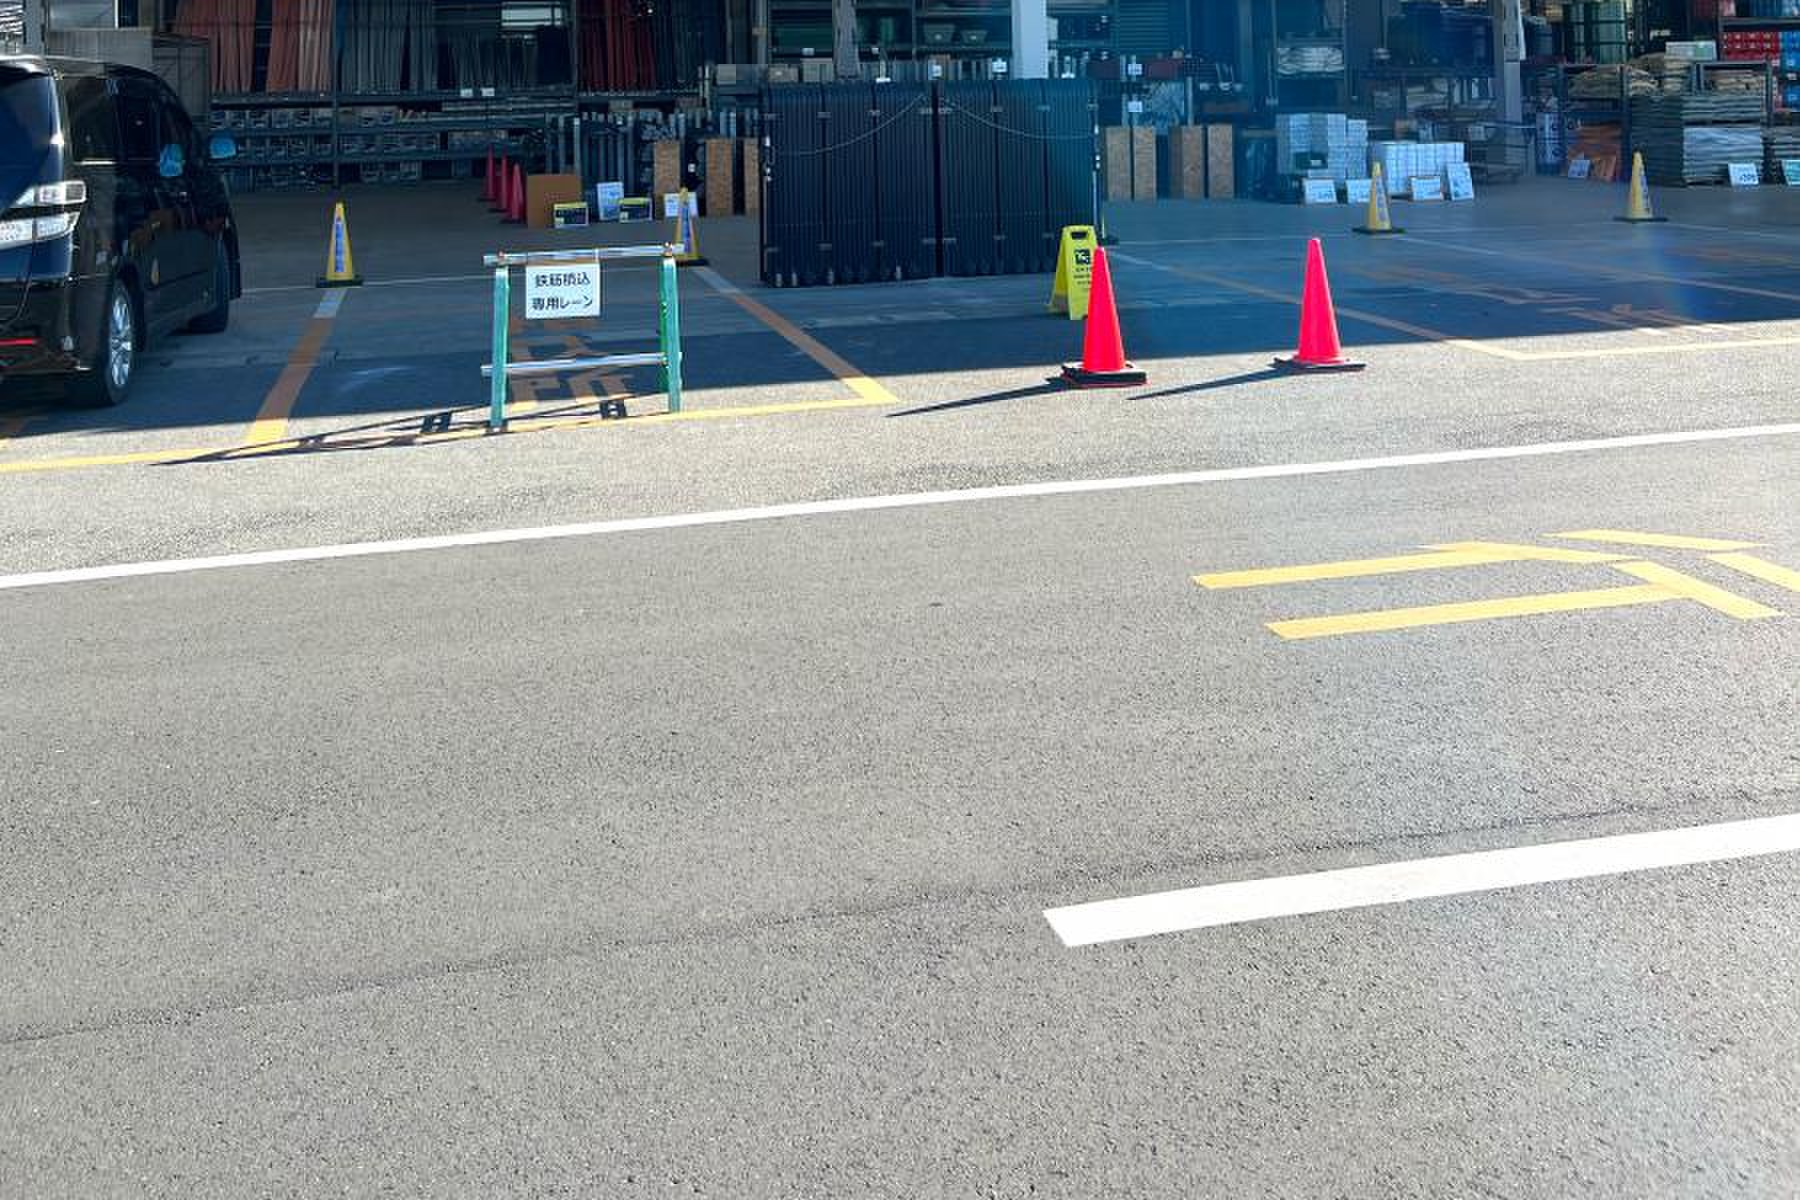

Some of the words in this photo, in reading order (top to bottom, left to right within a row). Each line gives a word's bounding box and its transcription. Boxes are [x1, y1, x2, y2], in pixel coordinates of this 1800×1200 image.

[532, 295, 593, 311] 専用レーン
